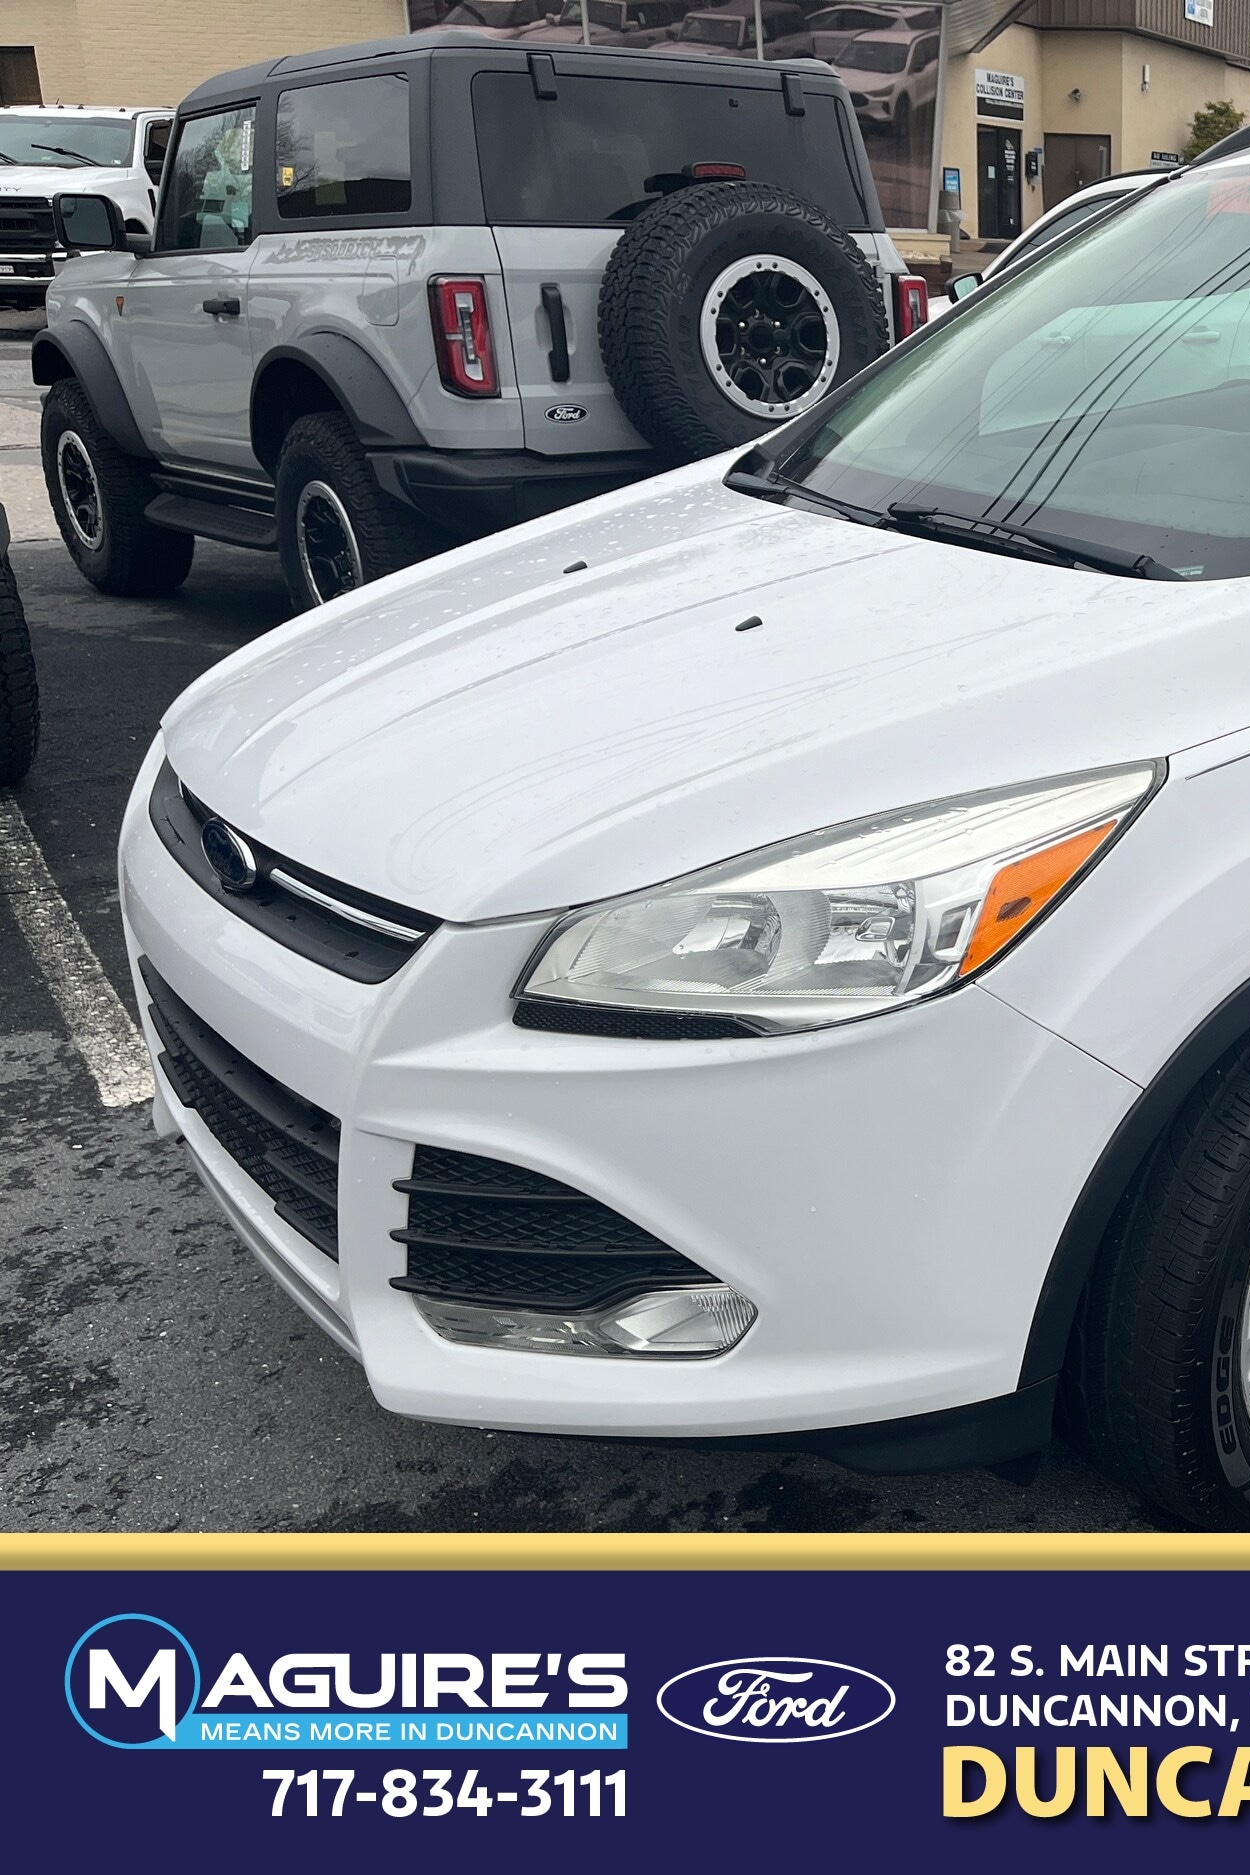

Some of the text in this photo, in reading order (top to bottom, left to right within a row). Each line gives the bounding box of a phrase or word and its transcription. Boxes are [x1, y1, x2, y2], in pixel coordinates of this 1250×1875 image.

[976, 83, 1024, 100] COLLISION CENTER
[554, 407, 581, 420] Ford
[1215, 1314, 1236, 1456] EDGE
